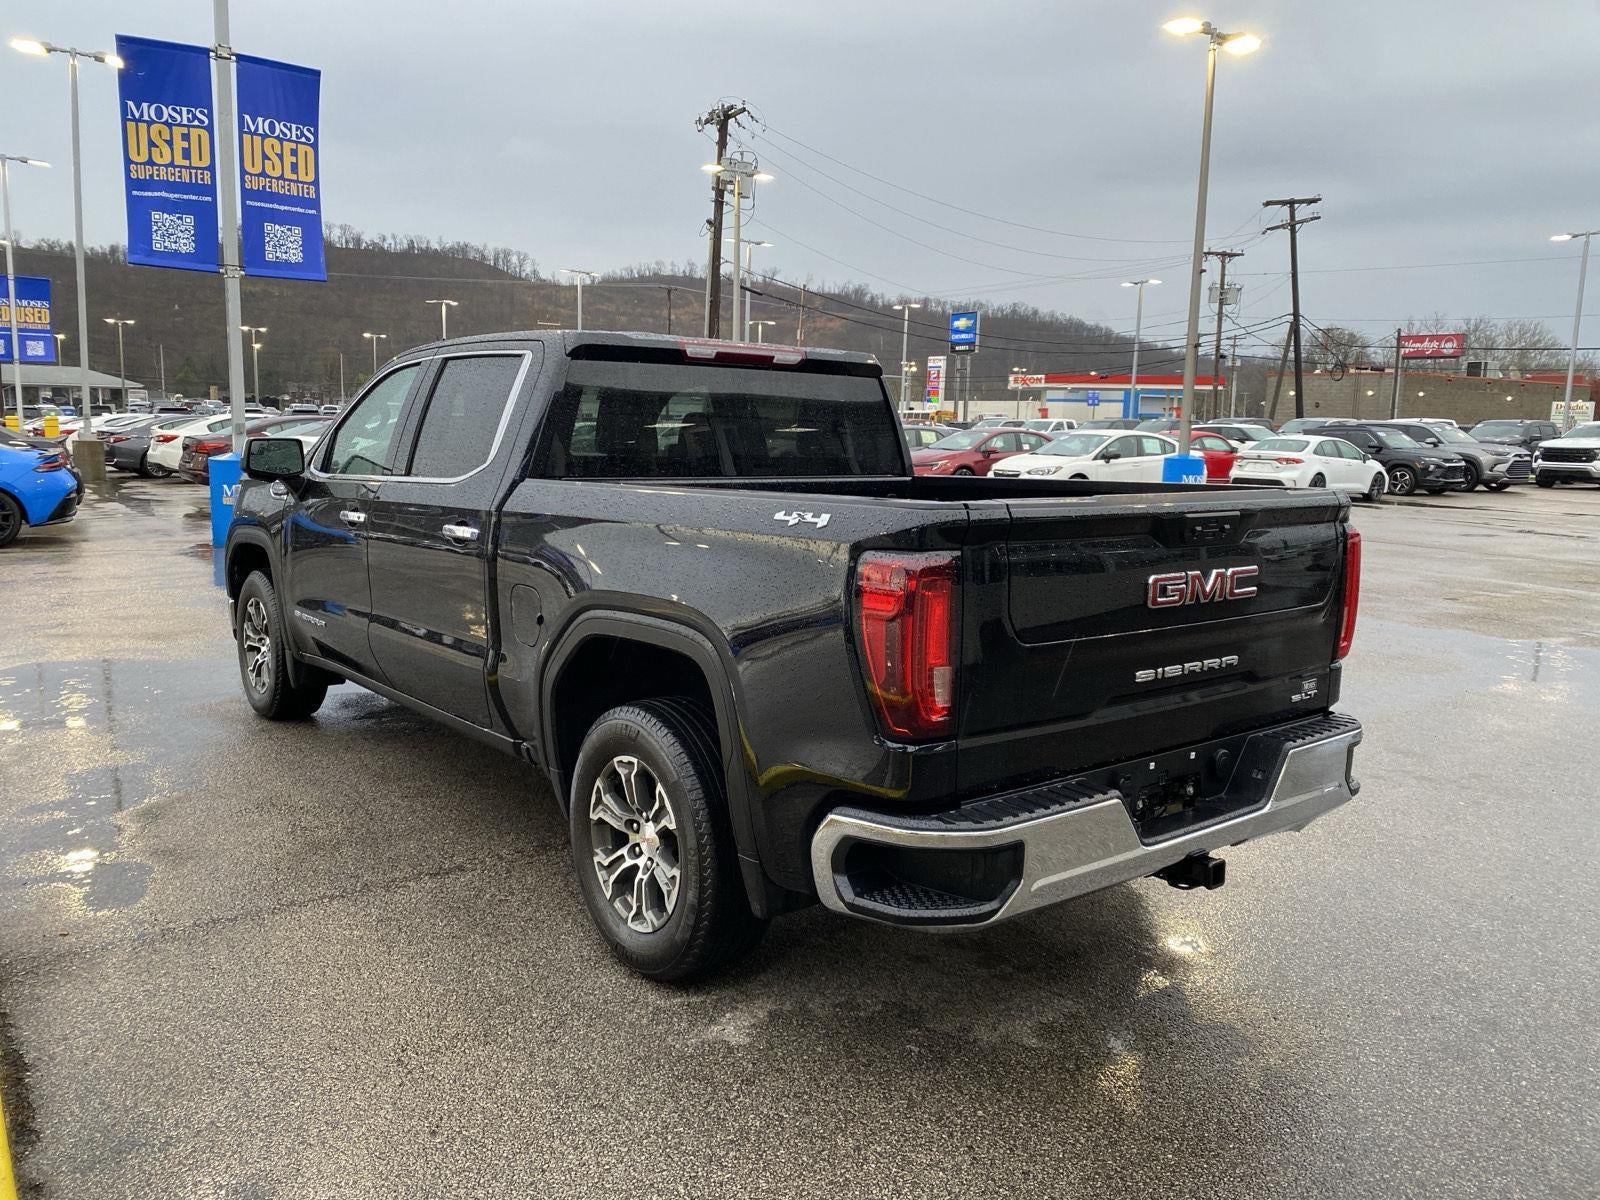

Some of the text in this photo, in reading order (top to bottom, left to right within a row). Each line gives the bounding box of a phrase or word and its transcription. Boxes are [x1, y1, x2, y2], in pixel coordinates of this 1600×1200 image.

[126, 101, 208, 126] MOSES
[243, 113, 314, 144] MOSES
[127, 121, 211, 167] USED
[243, 133, 315, 182] USED
[130, 164, 211, 185] SUPERCENTER
[132, 189, 212, 202] mosesusedsupercenter.com
[245, 175, 315, 199] SUPERCENTER
[246, 200, 317, 215] mosesusedsupercenter.com
[16, 299, 49, 308] MOSES
[16, 306, 50, 323] USED
[1401, 338, 1440, 355] Wendy's
[1013, 374, 1043, 386] EXXON
[1555, 403, 1590, 411] Dight's
[1147, 565, 1259, 609] GMC
[1135, 655, 1239, 683] SIERRA
[1291, 690, 1318, 703] SLT
